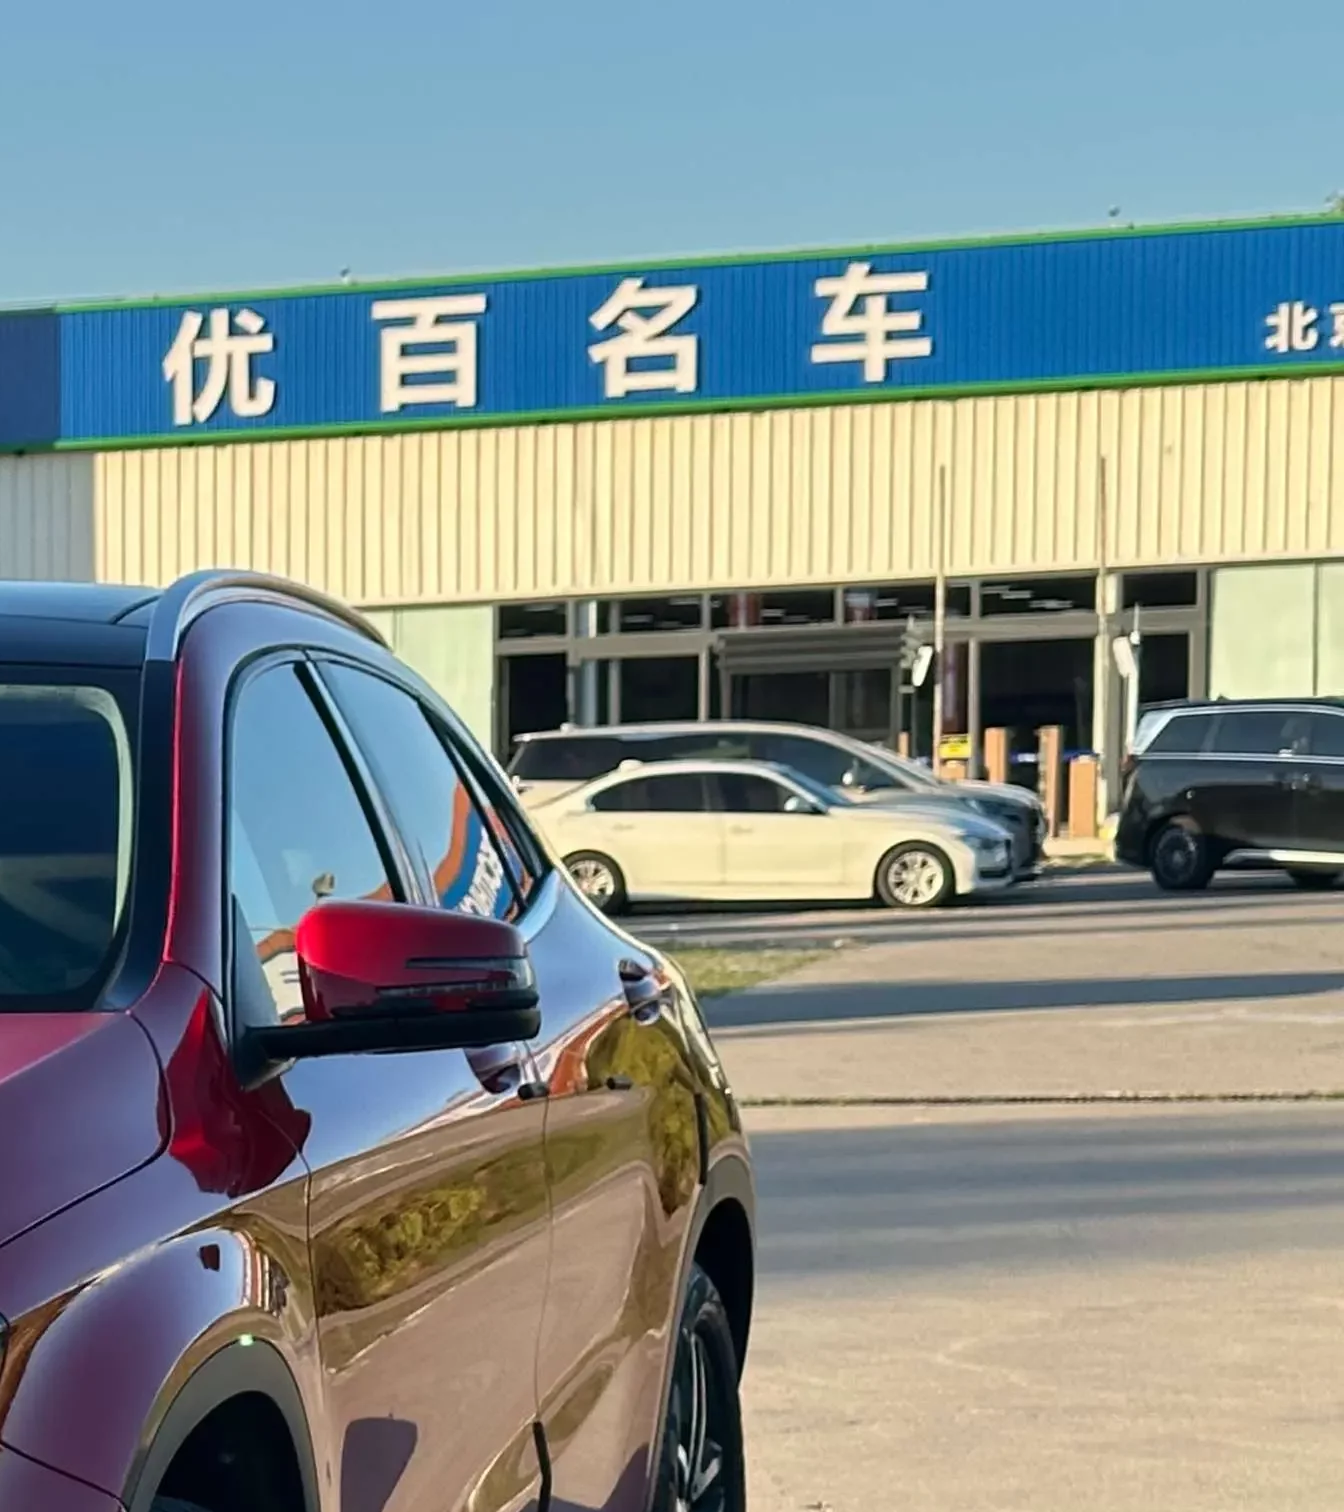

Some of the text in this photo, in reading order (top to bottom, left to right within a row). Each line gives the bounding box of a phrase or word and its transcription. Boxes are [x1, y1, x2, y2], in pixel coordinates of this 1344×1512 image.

[162, 261, 934, 427] 优百名车
[1264, 300, 1344, 353] 北
